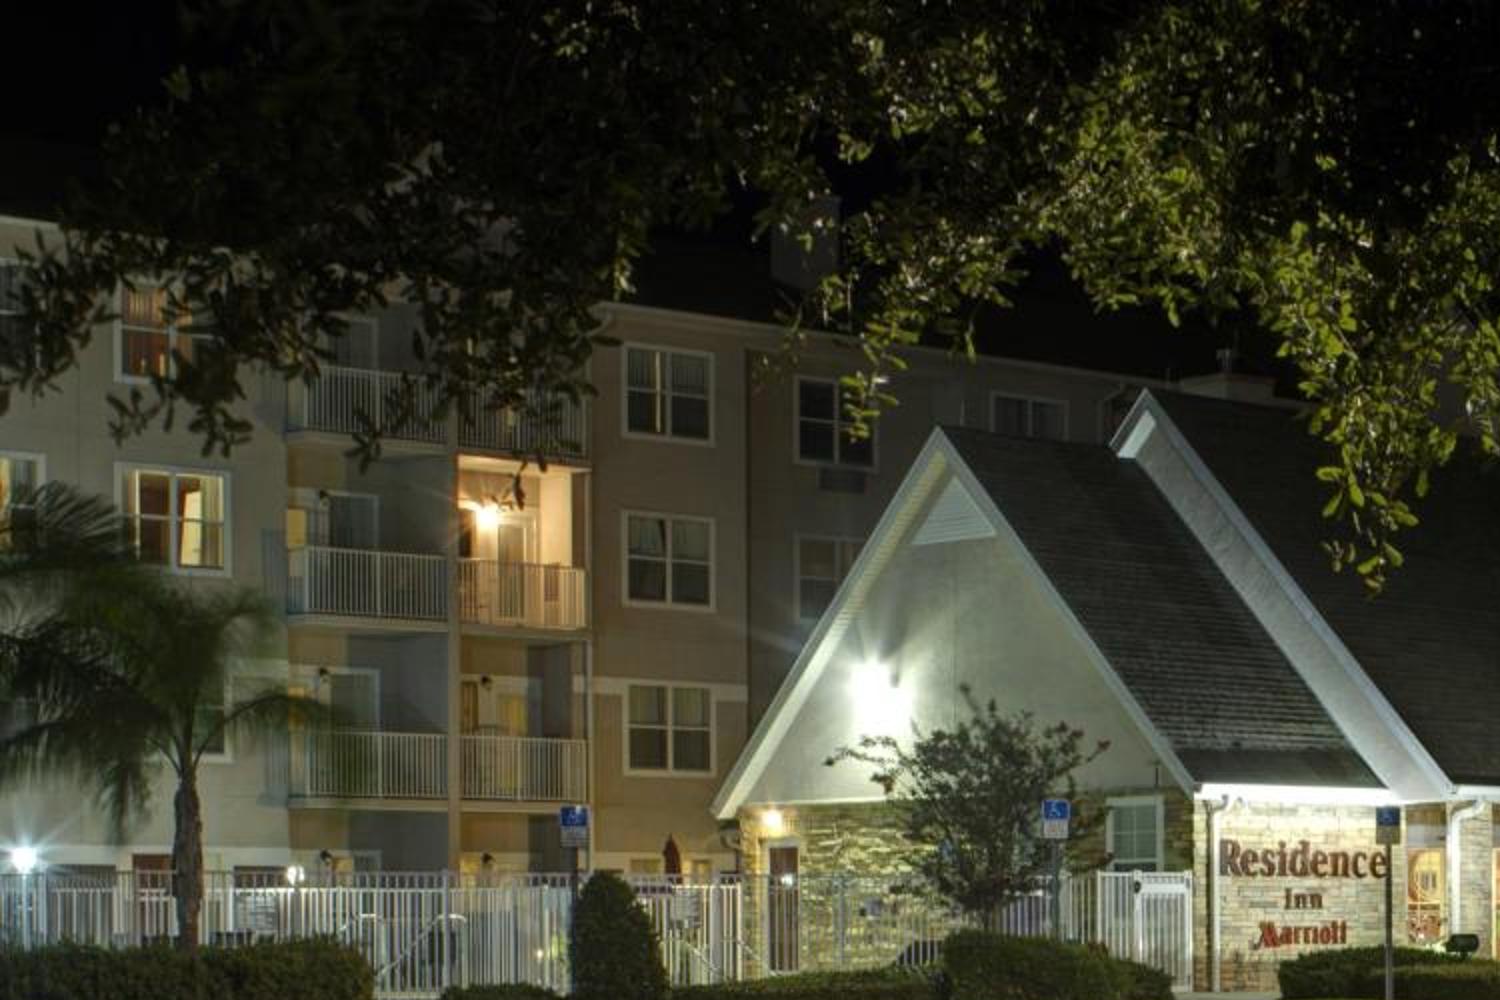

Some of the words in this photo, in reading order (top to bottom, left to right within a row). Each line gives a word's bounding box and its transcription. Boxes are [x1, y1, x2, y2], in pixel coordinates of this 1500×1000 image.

[1219, 838, 1388, 878] Residence
[1284, 887, 1323, 910] Inn
[1250, 920, 1347, 950] Marriott
